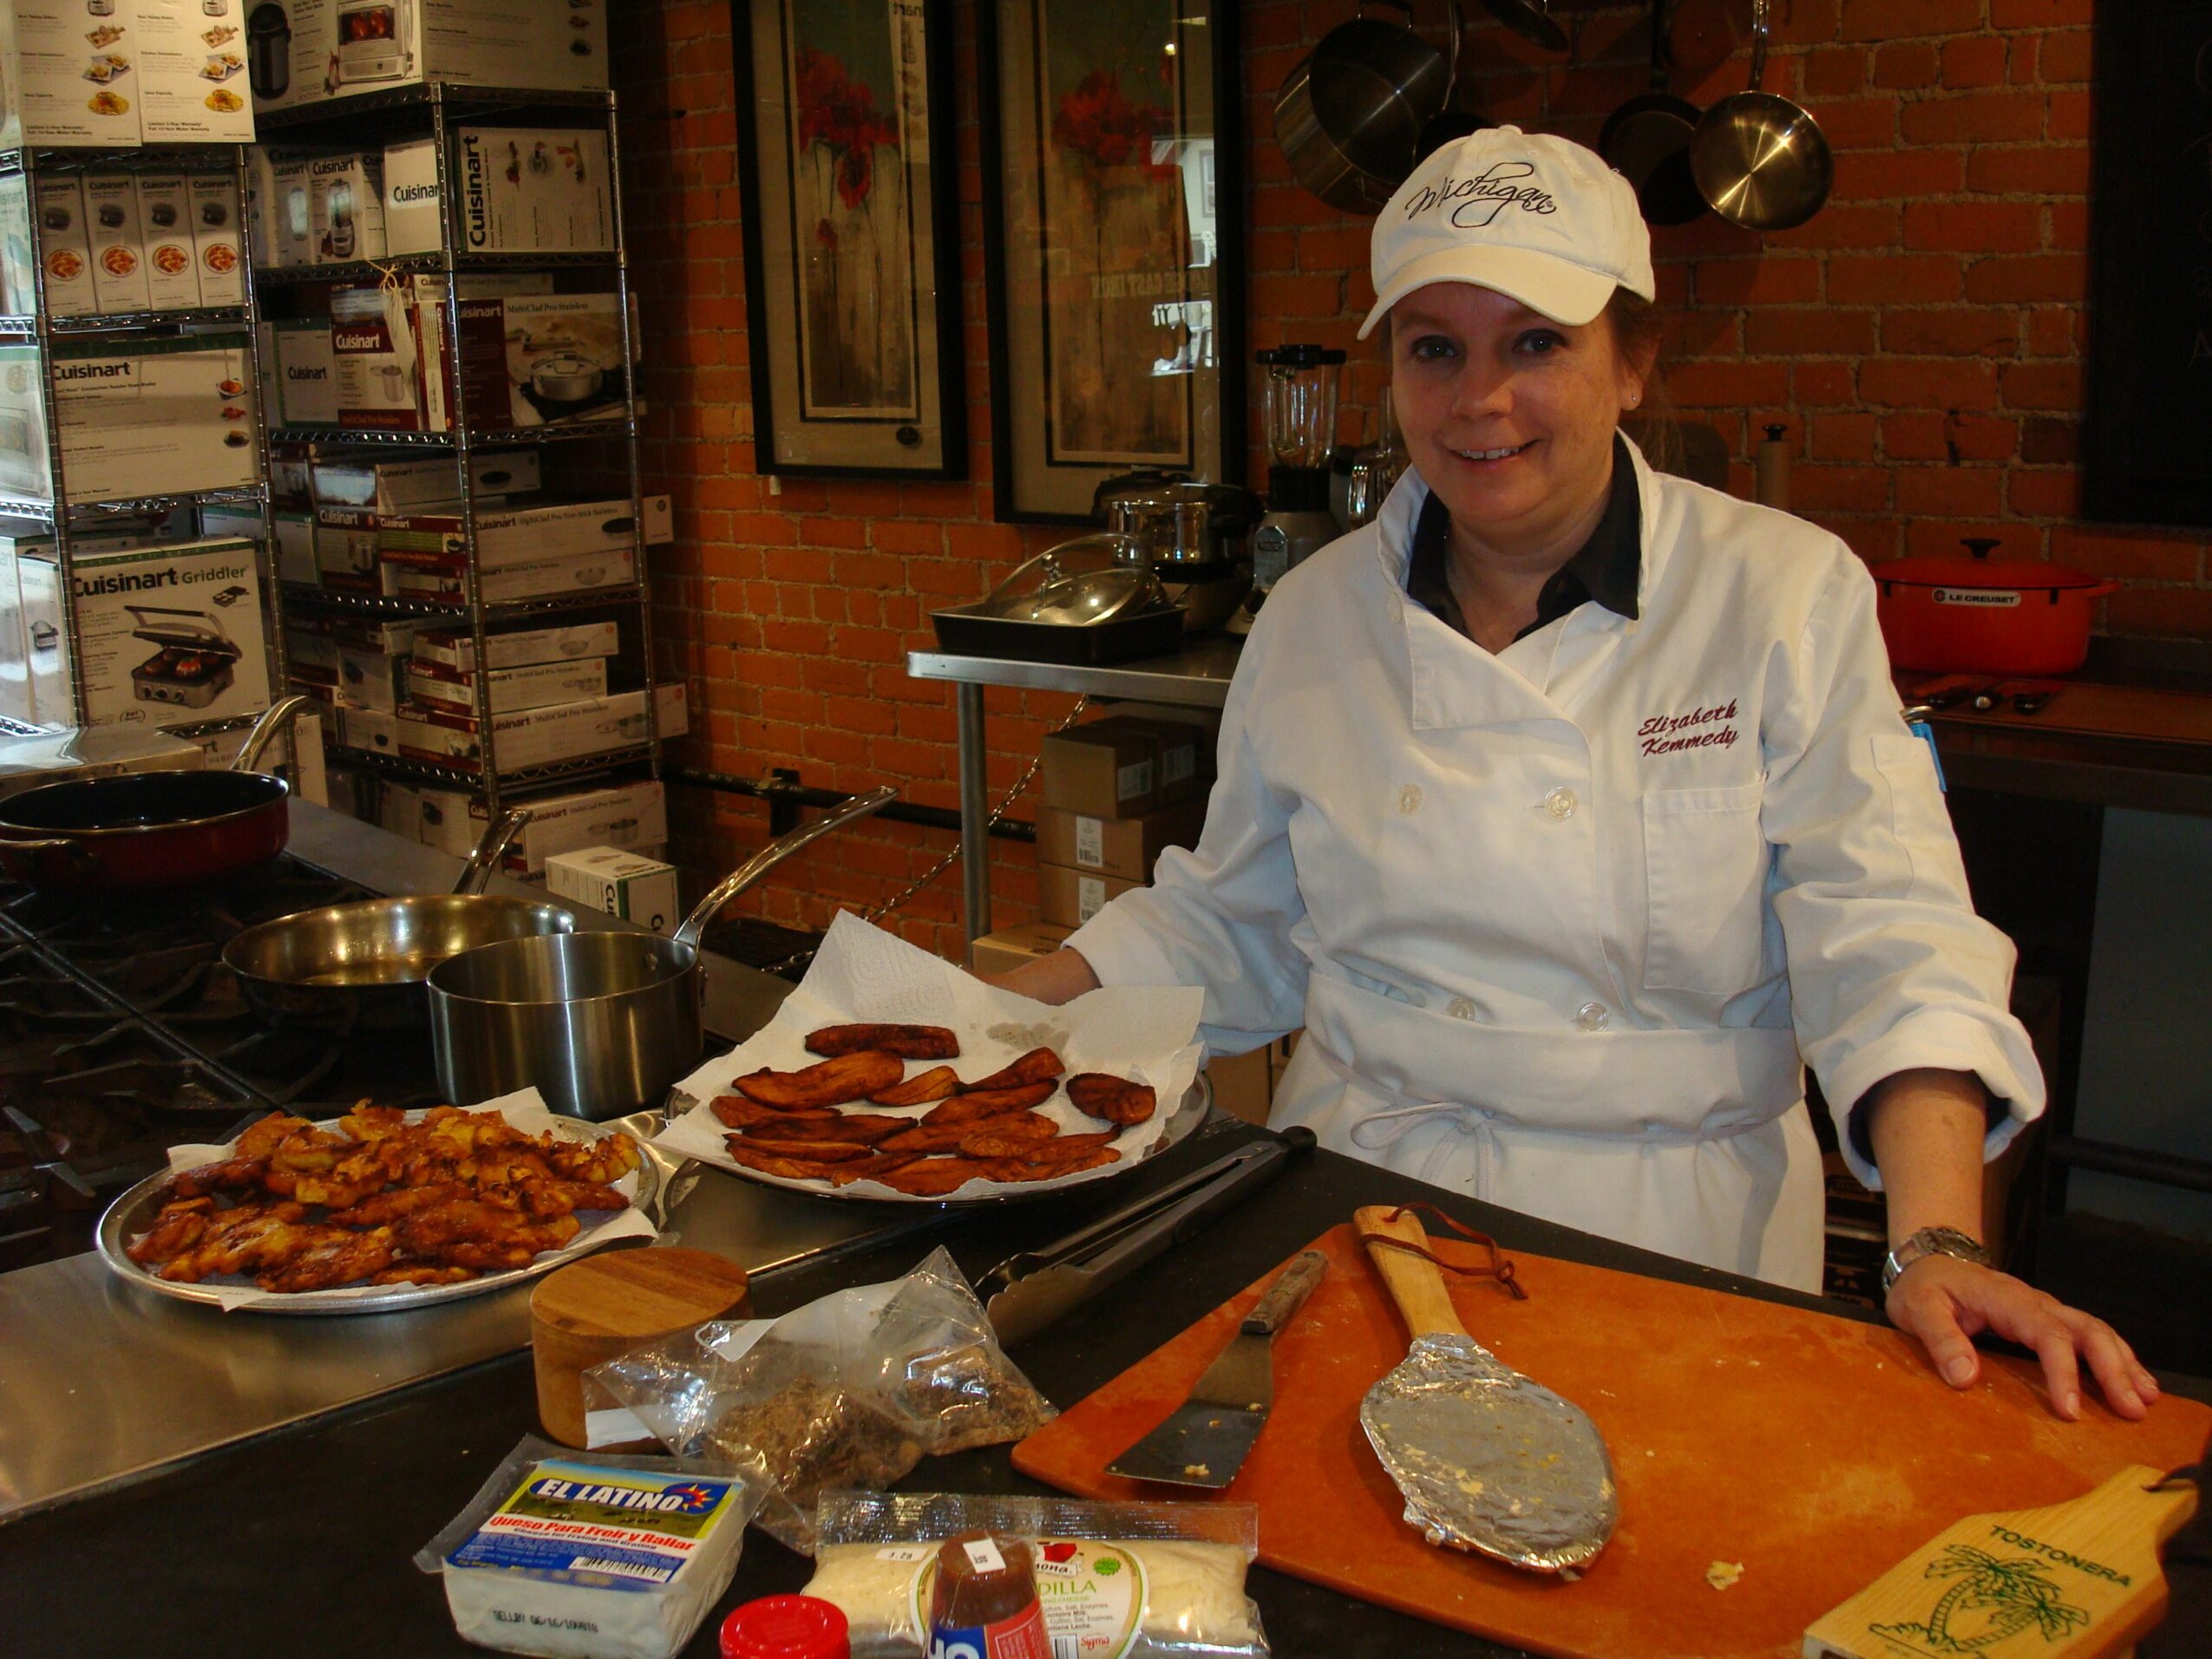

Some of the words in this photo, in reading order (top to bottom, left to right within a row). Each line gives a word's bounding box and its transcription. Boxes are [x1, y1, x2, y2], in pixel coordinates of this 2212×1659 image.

[312, 159, 355, 175] Cuisinart
[40, 181, 76, 191] uisinart
[89, 180, 129, 190] Cuisinart
[142, 180, 181, 190] Cuisinart
[193, 180, 232, 189] Cuisinart
[393, 182, 440, 202] Cuisinar
[464, 135, 486, 247] Cuisinart
[1404, 162, 1557, 228] Michigan
[421, 278, 447, 287] Cuisin
[459, 304, 502, 318] uisinart
[507, 302, 544, 312] MultiClad
[545, 302, 557, 311] Pro
[559, 301, 589, 310] Stainless
[336, 333, 381, 349] Cuisinart
[288, 365, 327, 381] Cuisinart
[319, 509, 358, 526] Cuisinart
[181, 566, 246, 584] Griddler
[1948, 593, 1963, 602] LE
[1964, 595, 2016, 604] CREUSET
[1638, 698, 1738, 737] Elizabeth
[536, 1478, 573, 1499] EL
[573, 1484, 684, 1511] LATINO
[490, 1516, 544, 1530] Queso
[544, 1522, 585, 1533] Para
[628, 1533, 641, 1542] y
[641, 1533, 697, 1551] Rallar
[514, 1527, 550, 1537] Cheese
[566, 1533, 599, 1542] Frying
[619, 1540, 658, 1550] Grating
[1990, 1525, 2131, 1588] TOSTONERA
[1081, 1636, 1110, 1651] Sigma
